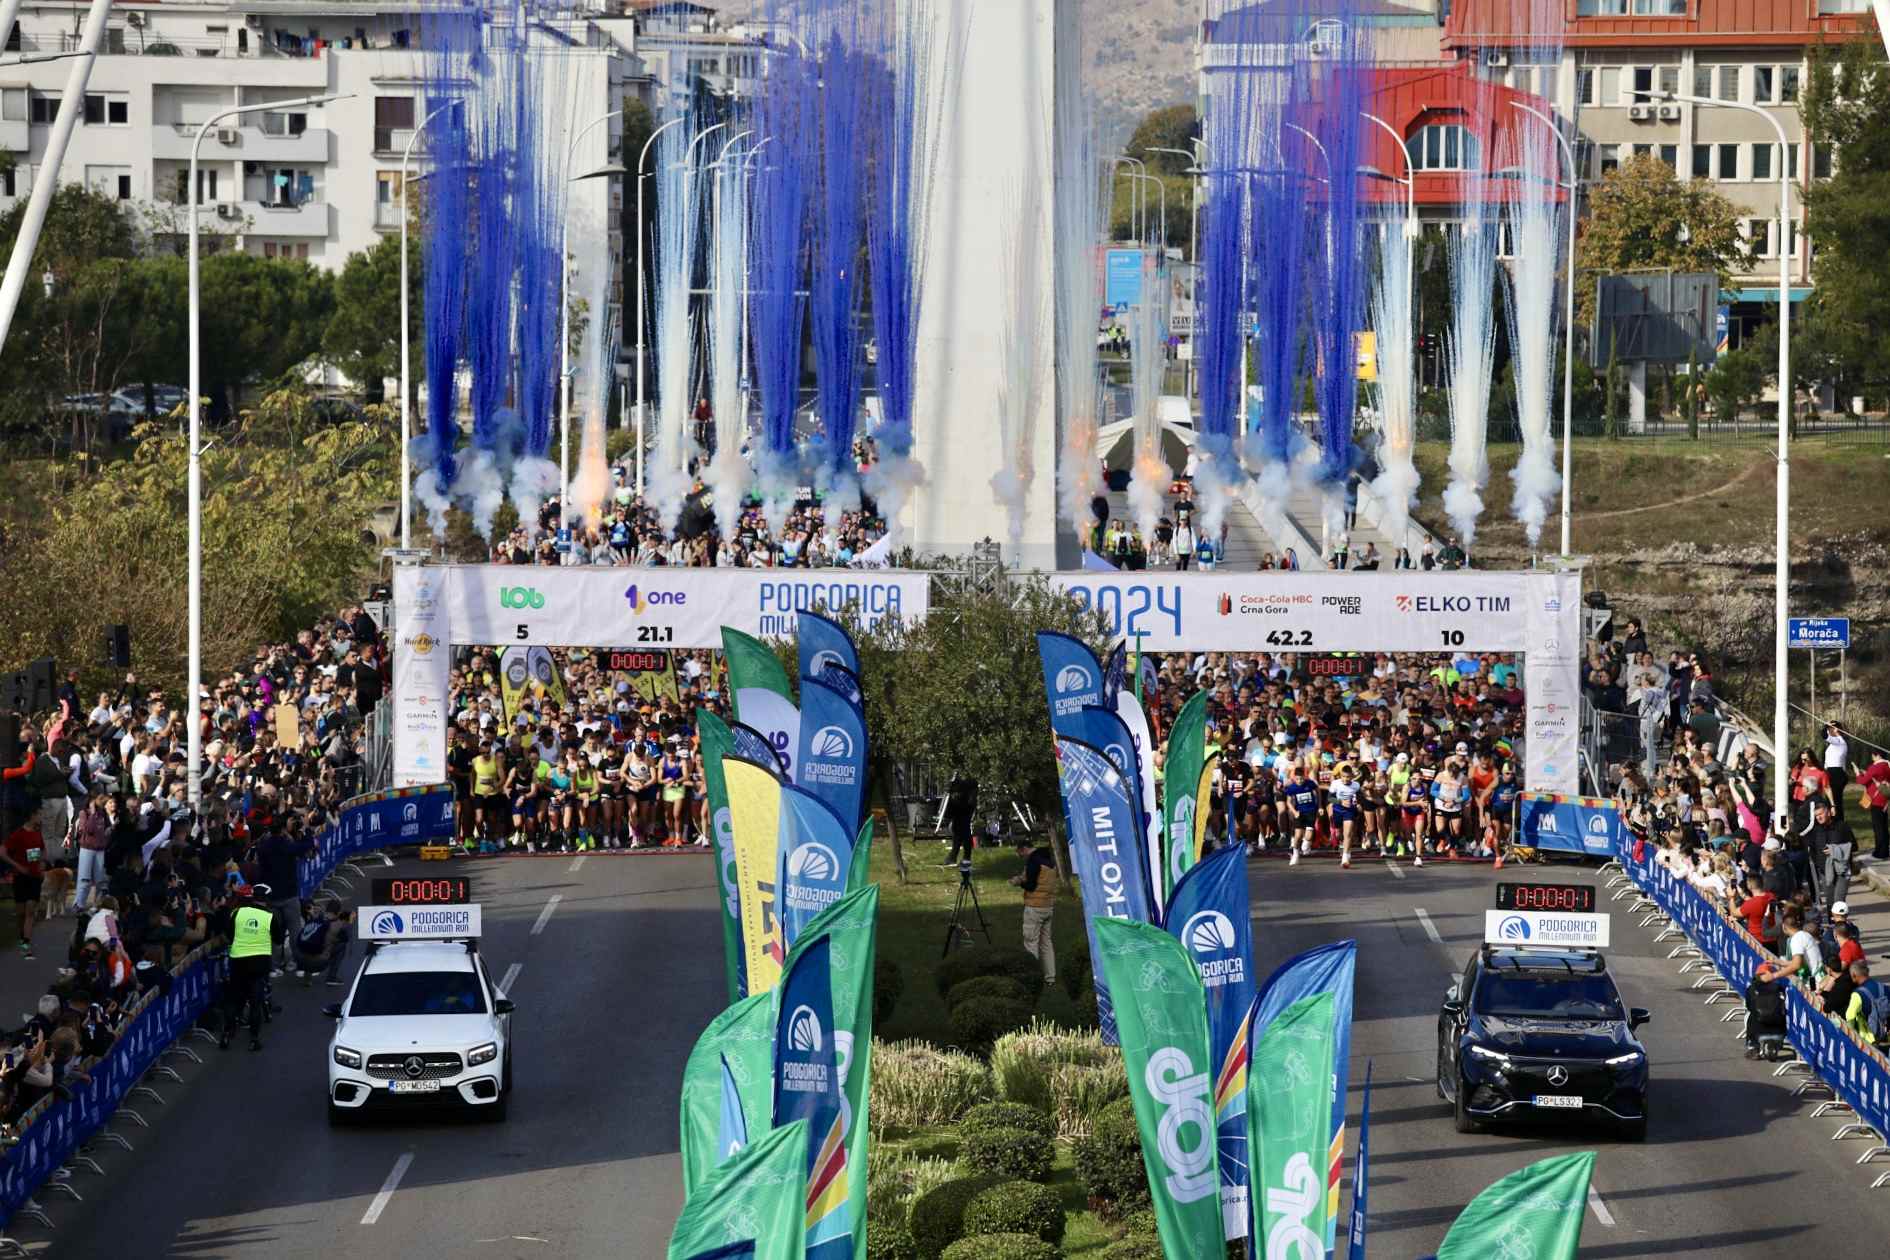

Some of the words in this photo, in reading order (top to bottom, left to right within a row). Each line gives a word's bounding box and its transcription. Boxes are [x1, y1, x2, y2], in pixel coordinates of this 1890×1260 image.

[647, 591, 686, 605] one
[760, 582, 902, 614] PODGORICA
[1292, 595, 1313, 604] HBC
[1322, 596, 1361, 606] POWER
[1416, 596, 1471, 612] ELKO
[1475, 596, 1510, 612] TIM
[1240, 605, 1263, 614] Crna
[1265, 605, 1288, 614] Gora
[1340, 606, 1361, 614] ADE
[516, 624, 529, 640] 5
[637, 626, 673, 642] 21.1
[1266, 630, 1313, 646] 42.2
[1441, 630, 1464, 646] 10
[1799, 627, 1838, 638] Morača
[611, 654, 664, 669] 0:00:01
[1309, 659, 1363, 675] 0:00:01
[391, 881, 464, 901] 0:00:01
[1516, 887, 1589, 908] 0:00:01
[411, 911, 469, 924] PODGORICA
[411, 925, 454, 933] MILLENNIUM
[455, 924, 469, 932] RUN
[1539, 919, 1597, 932] PODGORICA
[1538, 931, 1581, 941] MILLENNIUM
[1583, 932, 1597, 941] RUN
[1196, 957, 1244, 977] GORICA
[783, 1062, 828, 1080] PODGORICA
